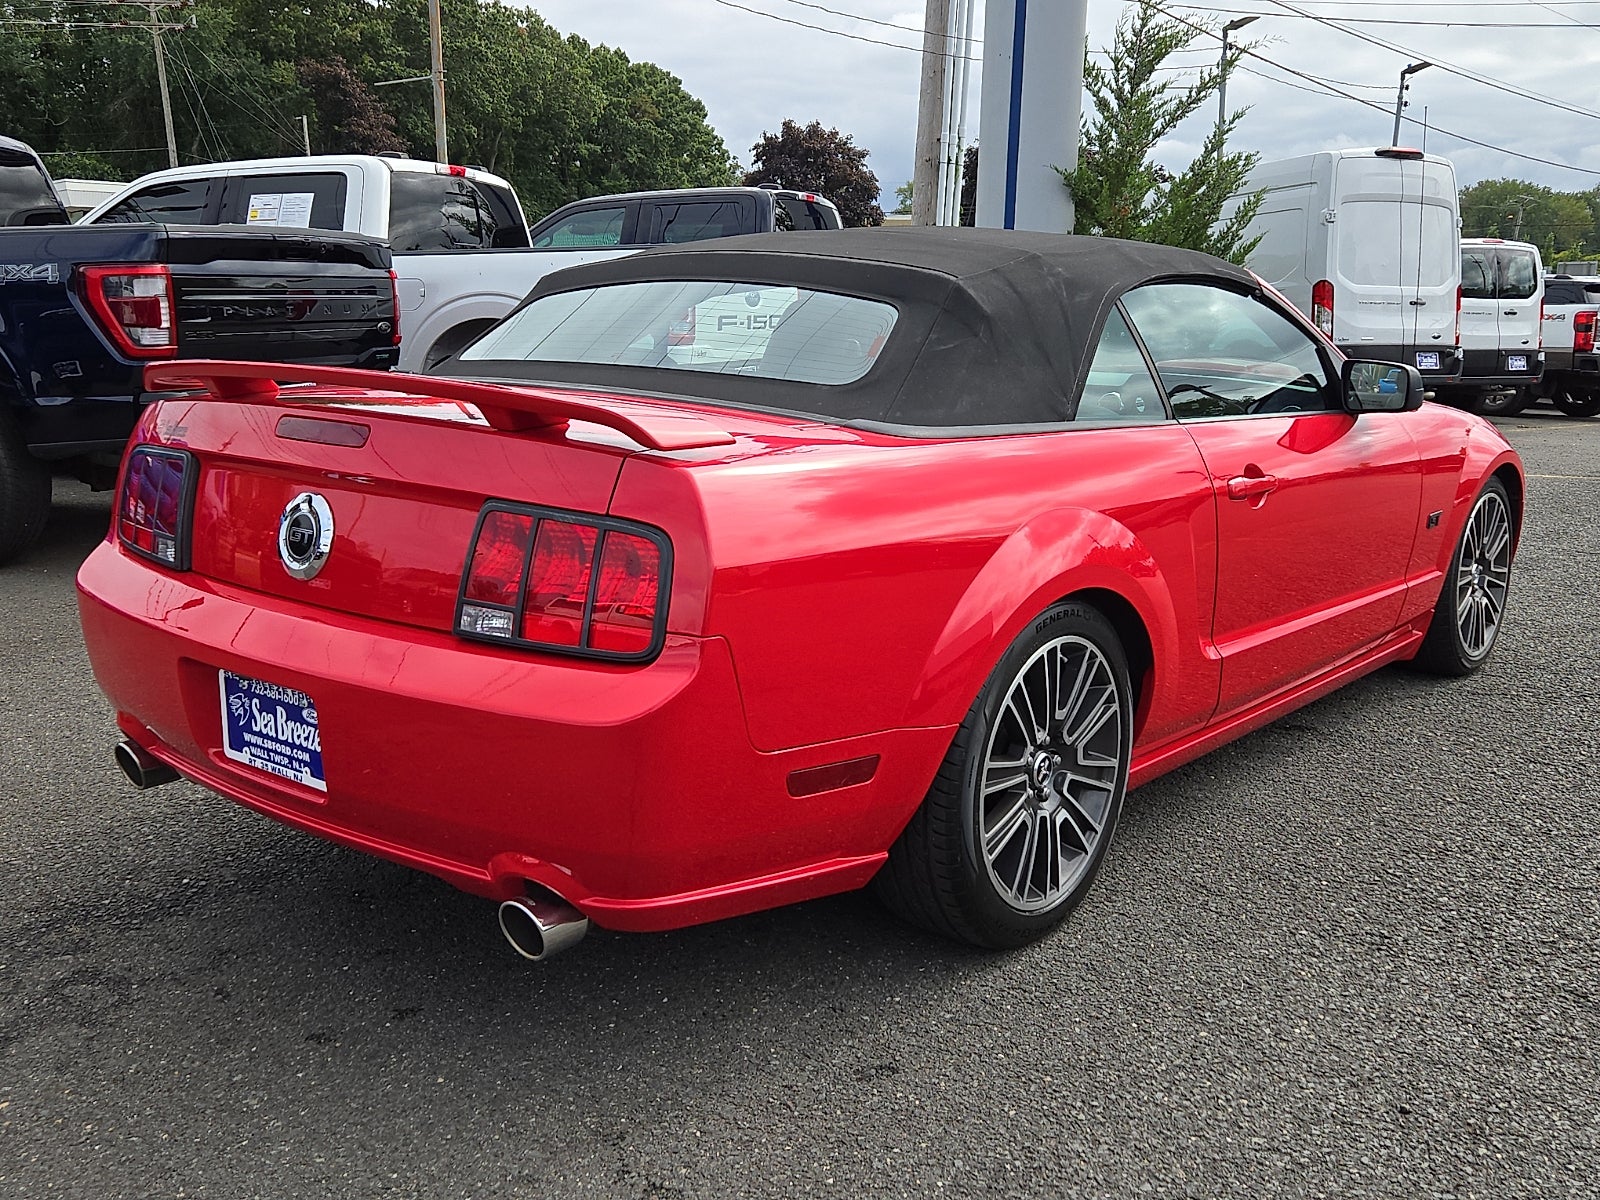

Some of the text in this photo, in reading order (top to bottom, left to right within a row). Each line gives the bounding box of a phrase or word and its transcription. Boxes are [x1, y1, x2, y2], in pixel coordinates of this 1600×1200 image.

[223, 305, 371, 317] PLATINUM
[289, 526, 314, 545] GT
[1035, 609, 1082, 634] GENERAL
[251, 698, 277, 738] Sea
[250, 745, 269, 760] WALL
[293, 772, 303, 783] NJ
